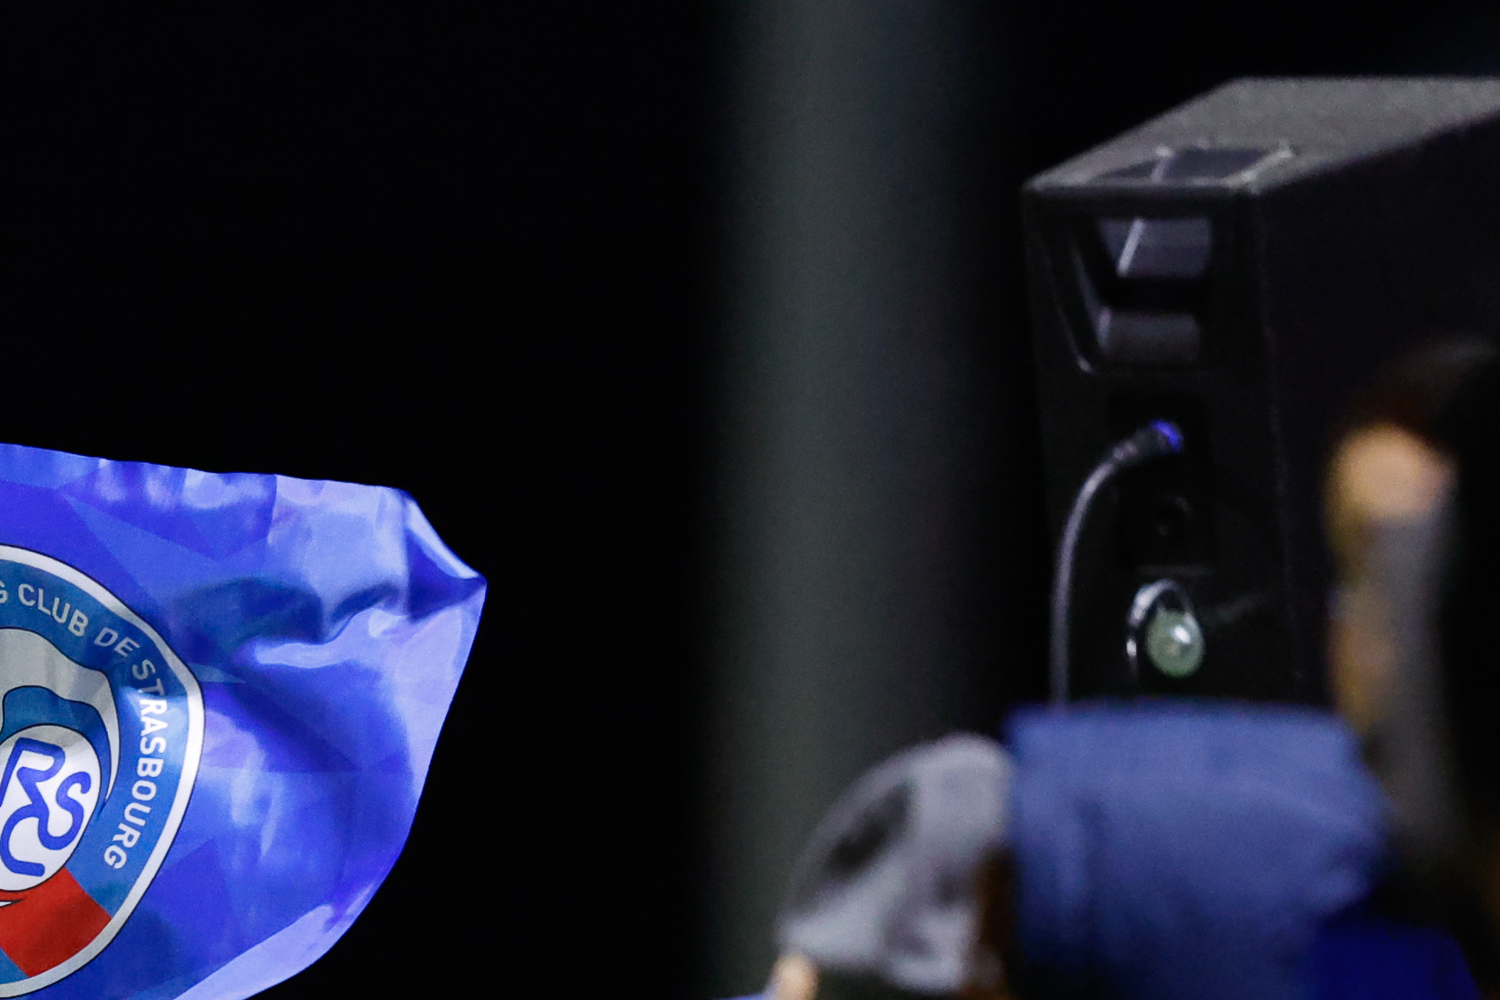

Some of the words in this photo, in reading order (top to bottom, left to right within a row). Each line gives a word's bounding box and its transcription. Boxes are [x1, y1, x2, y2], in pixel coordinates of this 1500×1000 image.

[18, 583, 89, 638] CLUB
[94, 627, 141, 660] DE
[104, 658, 167, 870] STRASBOURG
